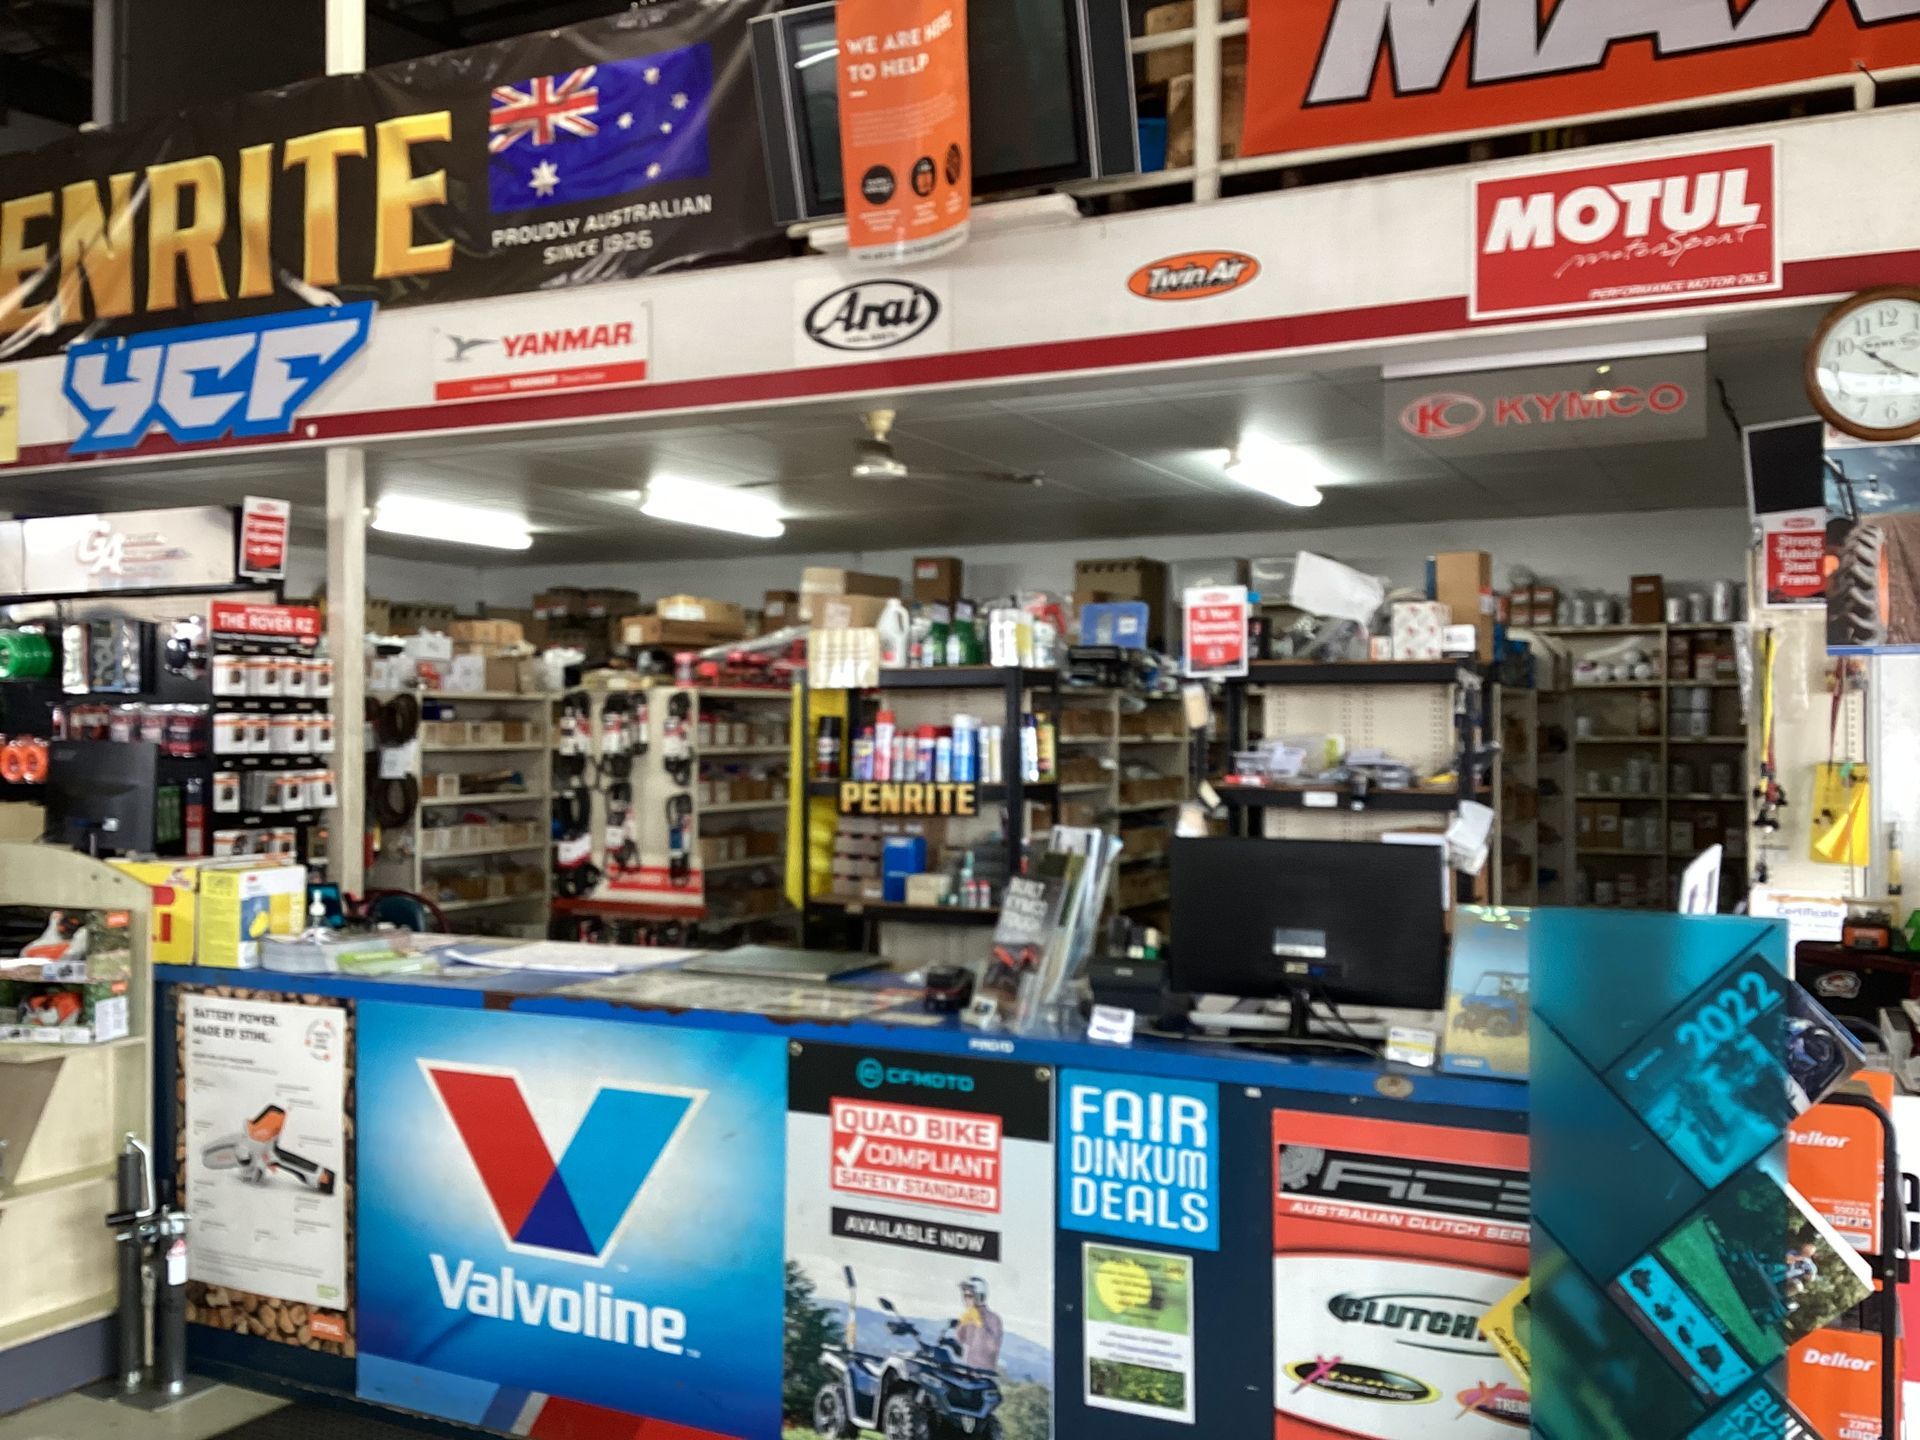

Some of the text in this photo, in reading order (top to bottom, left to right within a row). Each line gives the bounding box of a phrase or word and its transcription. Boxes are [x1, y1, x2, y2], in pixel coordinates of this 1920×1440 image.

[882, 27, 921, 51] ARE
[847, 52, 929, 83] TO HELP
[491, 194, 712, 248] PROUDLY AUSTRALIAN
[1484, 168, 1761, 254] MOTUL
[542, 229, 653, 265] SINCE 1926
[1149, 262, 1208, 292] Twin
[1588, 271, 1769, 300] PERFORMANCE MOTOR OILS
[815, 289, 924, 334] Arai
[503, 320, 633, 358] YANMAR
[1494, 382, 1687, 427] KYMCO
[1777, 573, 1822, 586] Frame
[218, 611, 246, 629] THE
[249, 614, 293, 632] ROVER
[840, 781, 976, 814] PENRITE
[193, 1008, 279, 1027] BATTERY POWER.
[193, 1025, 220, 1038] MADE
[1675, 971, 1783, 1060] 2022
[886, 1067, 975, 1092] CFMOTO
[841, 1108, 992, 1147] QUAD BIKE
[1071, 1084, 1208, 1148] FAIR
[865, 1144, 997, 1180] COMPLIANT
[1071, 1134, 1208, 1190] DINKUM
[839, 1169, 992, 1204] SAFETY STANDARD
[1071, 1174, 1208, 1233] DEALS
[845, 1215, 986, 1252] AVAILABLE NOW
[1291, 1202, 1402, 1226] AUSTRALIAN
[1408, 1216, 1480, 1236] CLUTCH
[429, 1253, 687, 1356] Valvoline
[1338, 1296, 1488, 1342] CLUTCH
[1804, 1348, 1876, 1372] Delkor
